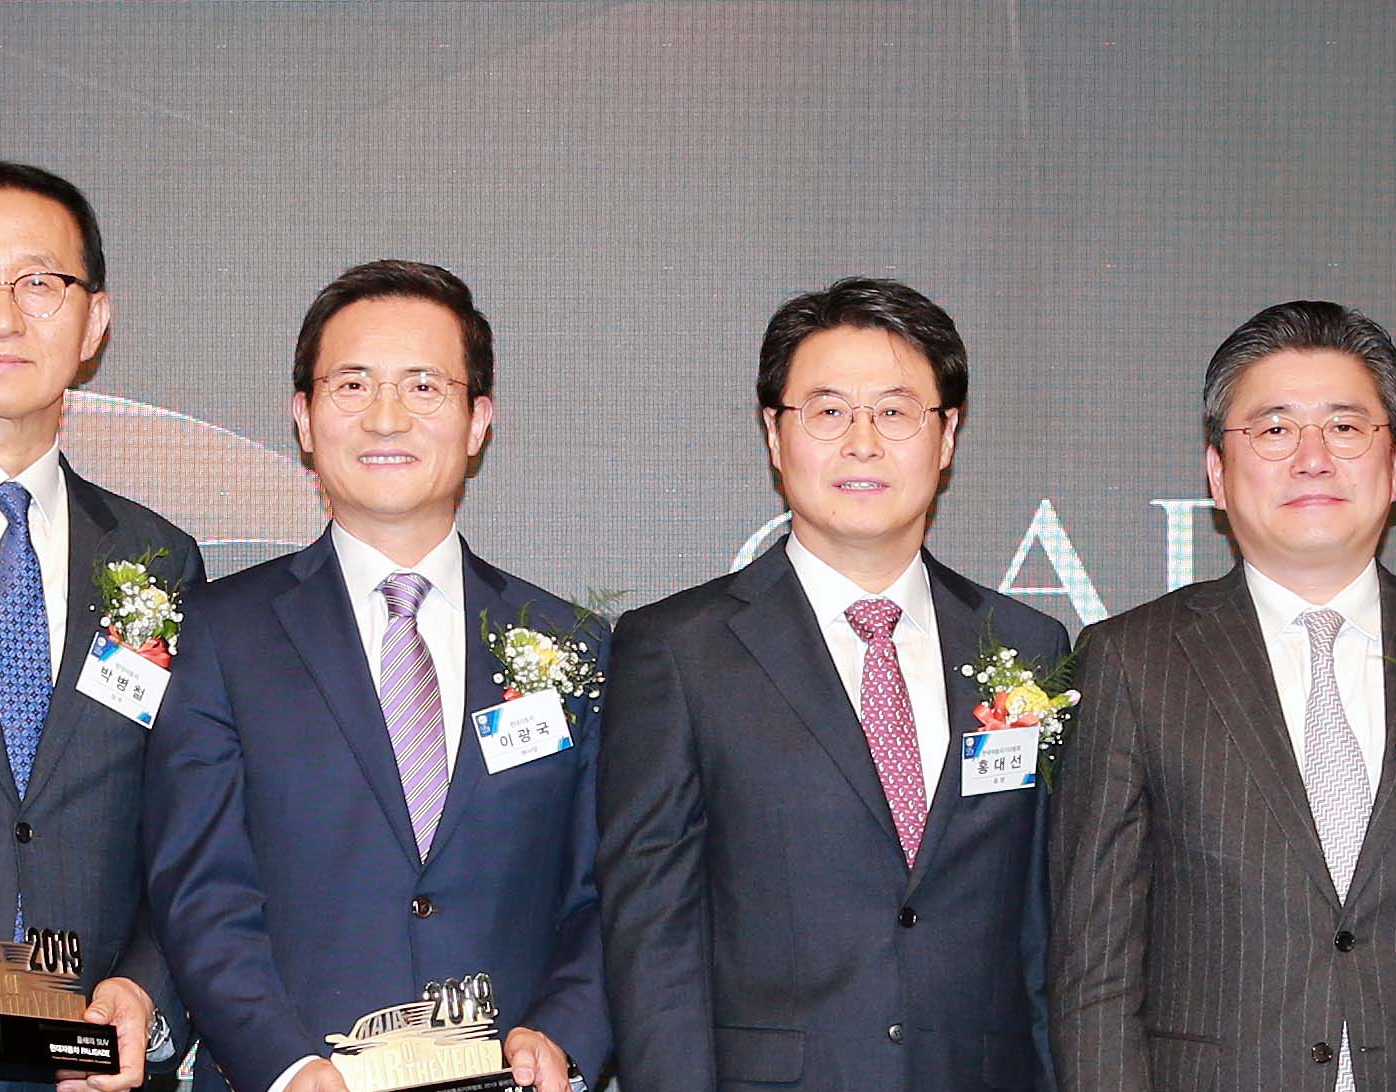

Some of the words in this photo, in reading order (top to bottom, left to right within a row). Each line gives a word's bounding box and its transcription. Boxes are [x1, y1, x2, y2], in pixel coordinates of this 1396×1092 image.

[25, 927, 82, 976] 2019
[422, 971, 499, 1028] 2019
[403, 1060, 441, 1086] THE
[438, 1043, 495, 1077] YEAR
